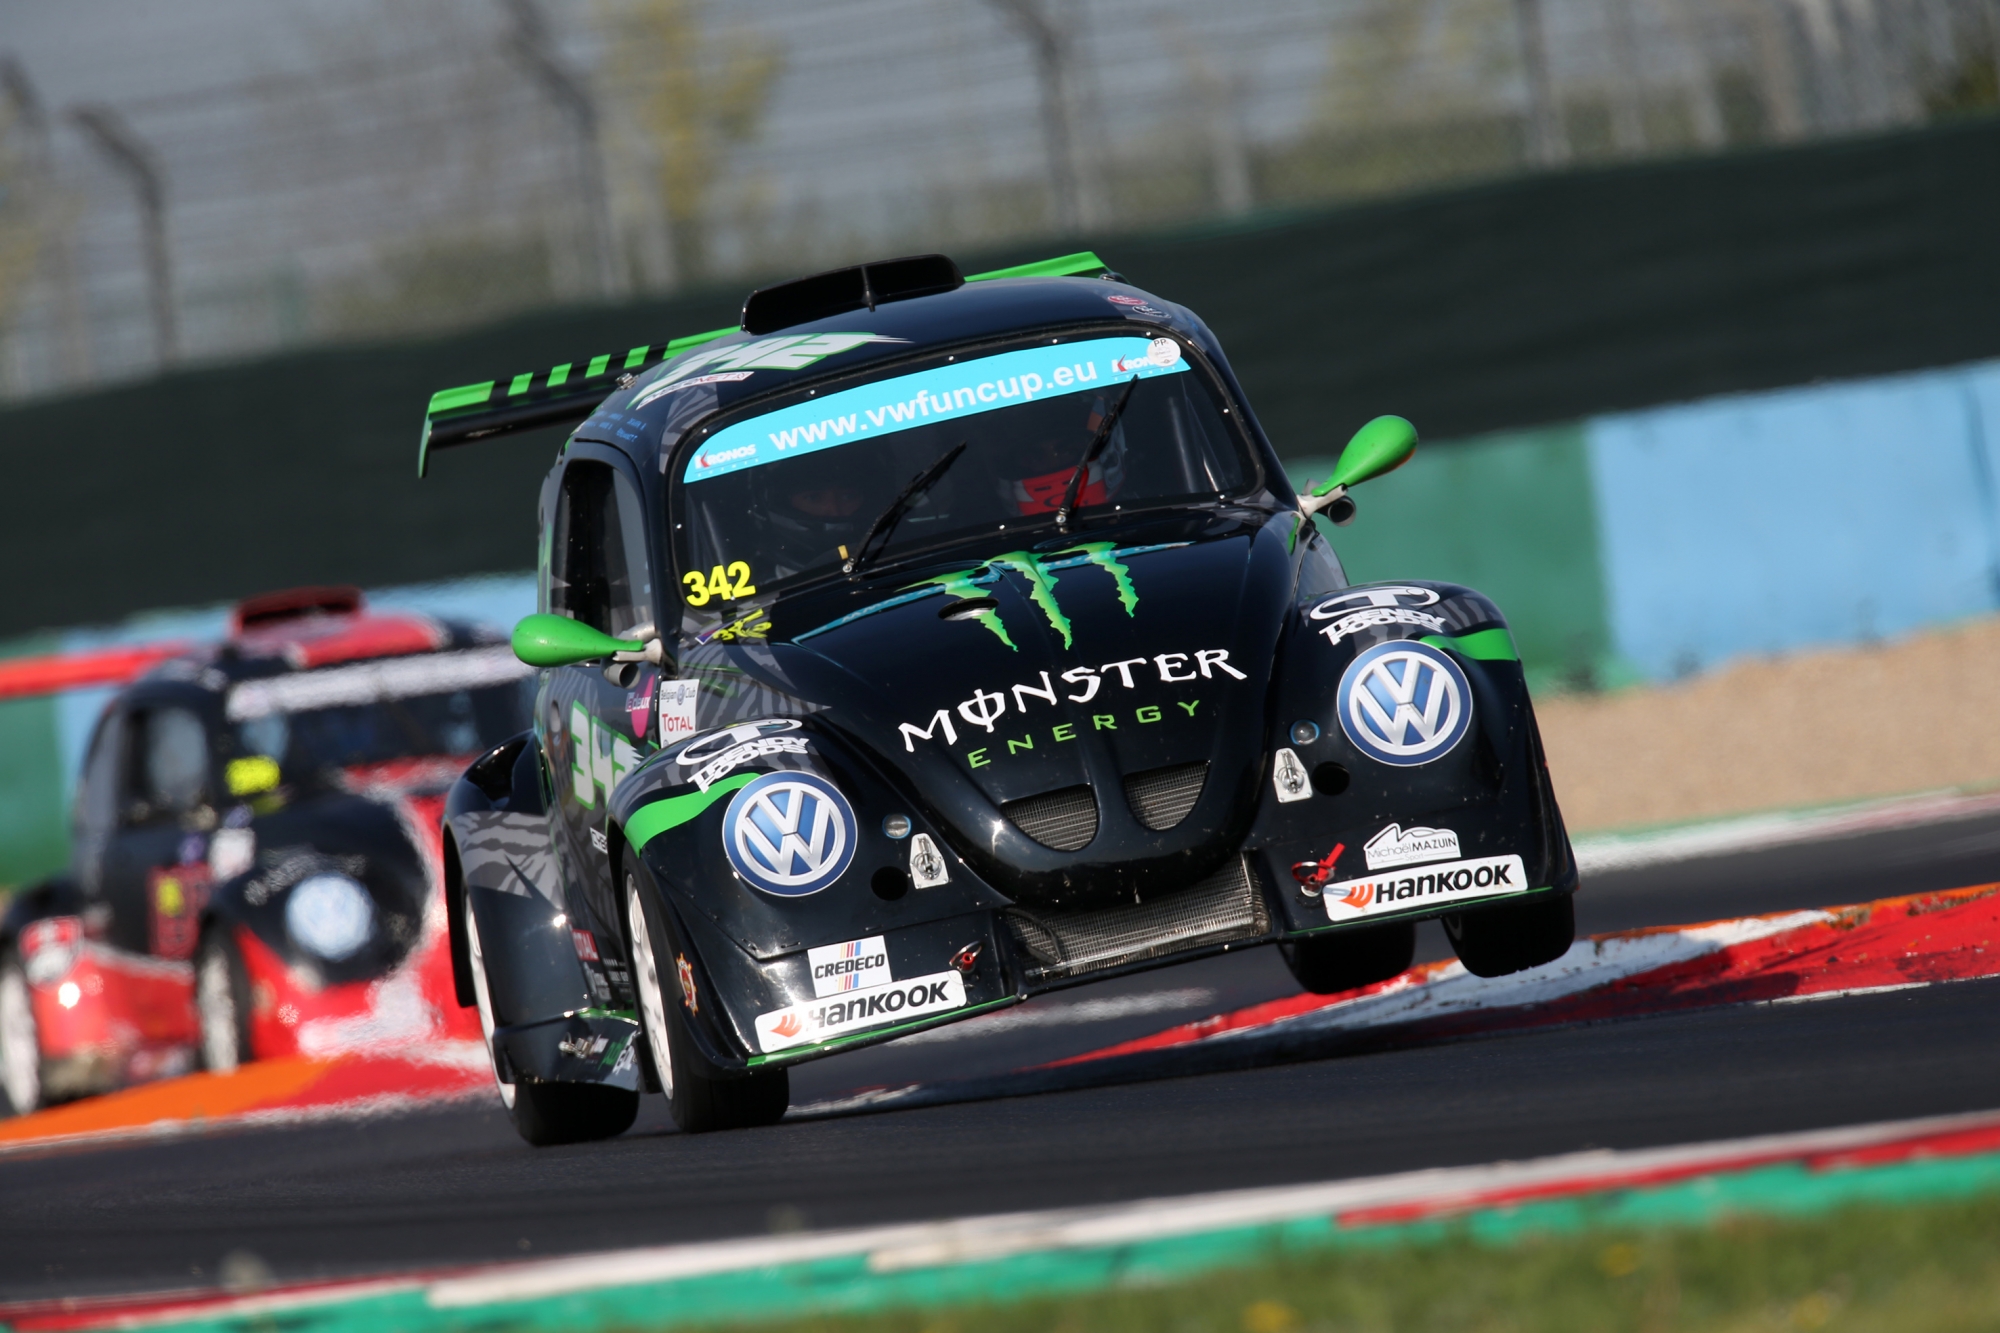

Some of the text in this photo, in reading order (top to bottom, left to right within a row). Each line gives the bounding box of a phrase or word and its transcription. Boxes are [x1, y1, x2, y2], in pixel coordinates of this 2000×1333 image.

[769, 361, 1097, 451] www.vwfuncup.eu
[694, 443, 757, 470] KRONOS
[682, 560, 756, 607] 342
[662, 713, 694, 732] TOTAL
[967, 700, 1200, 769] ENERGY
[814, 953, 885, 980] CREDECO
